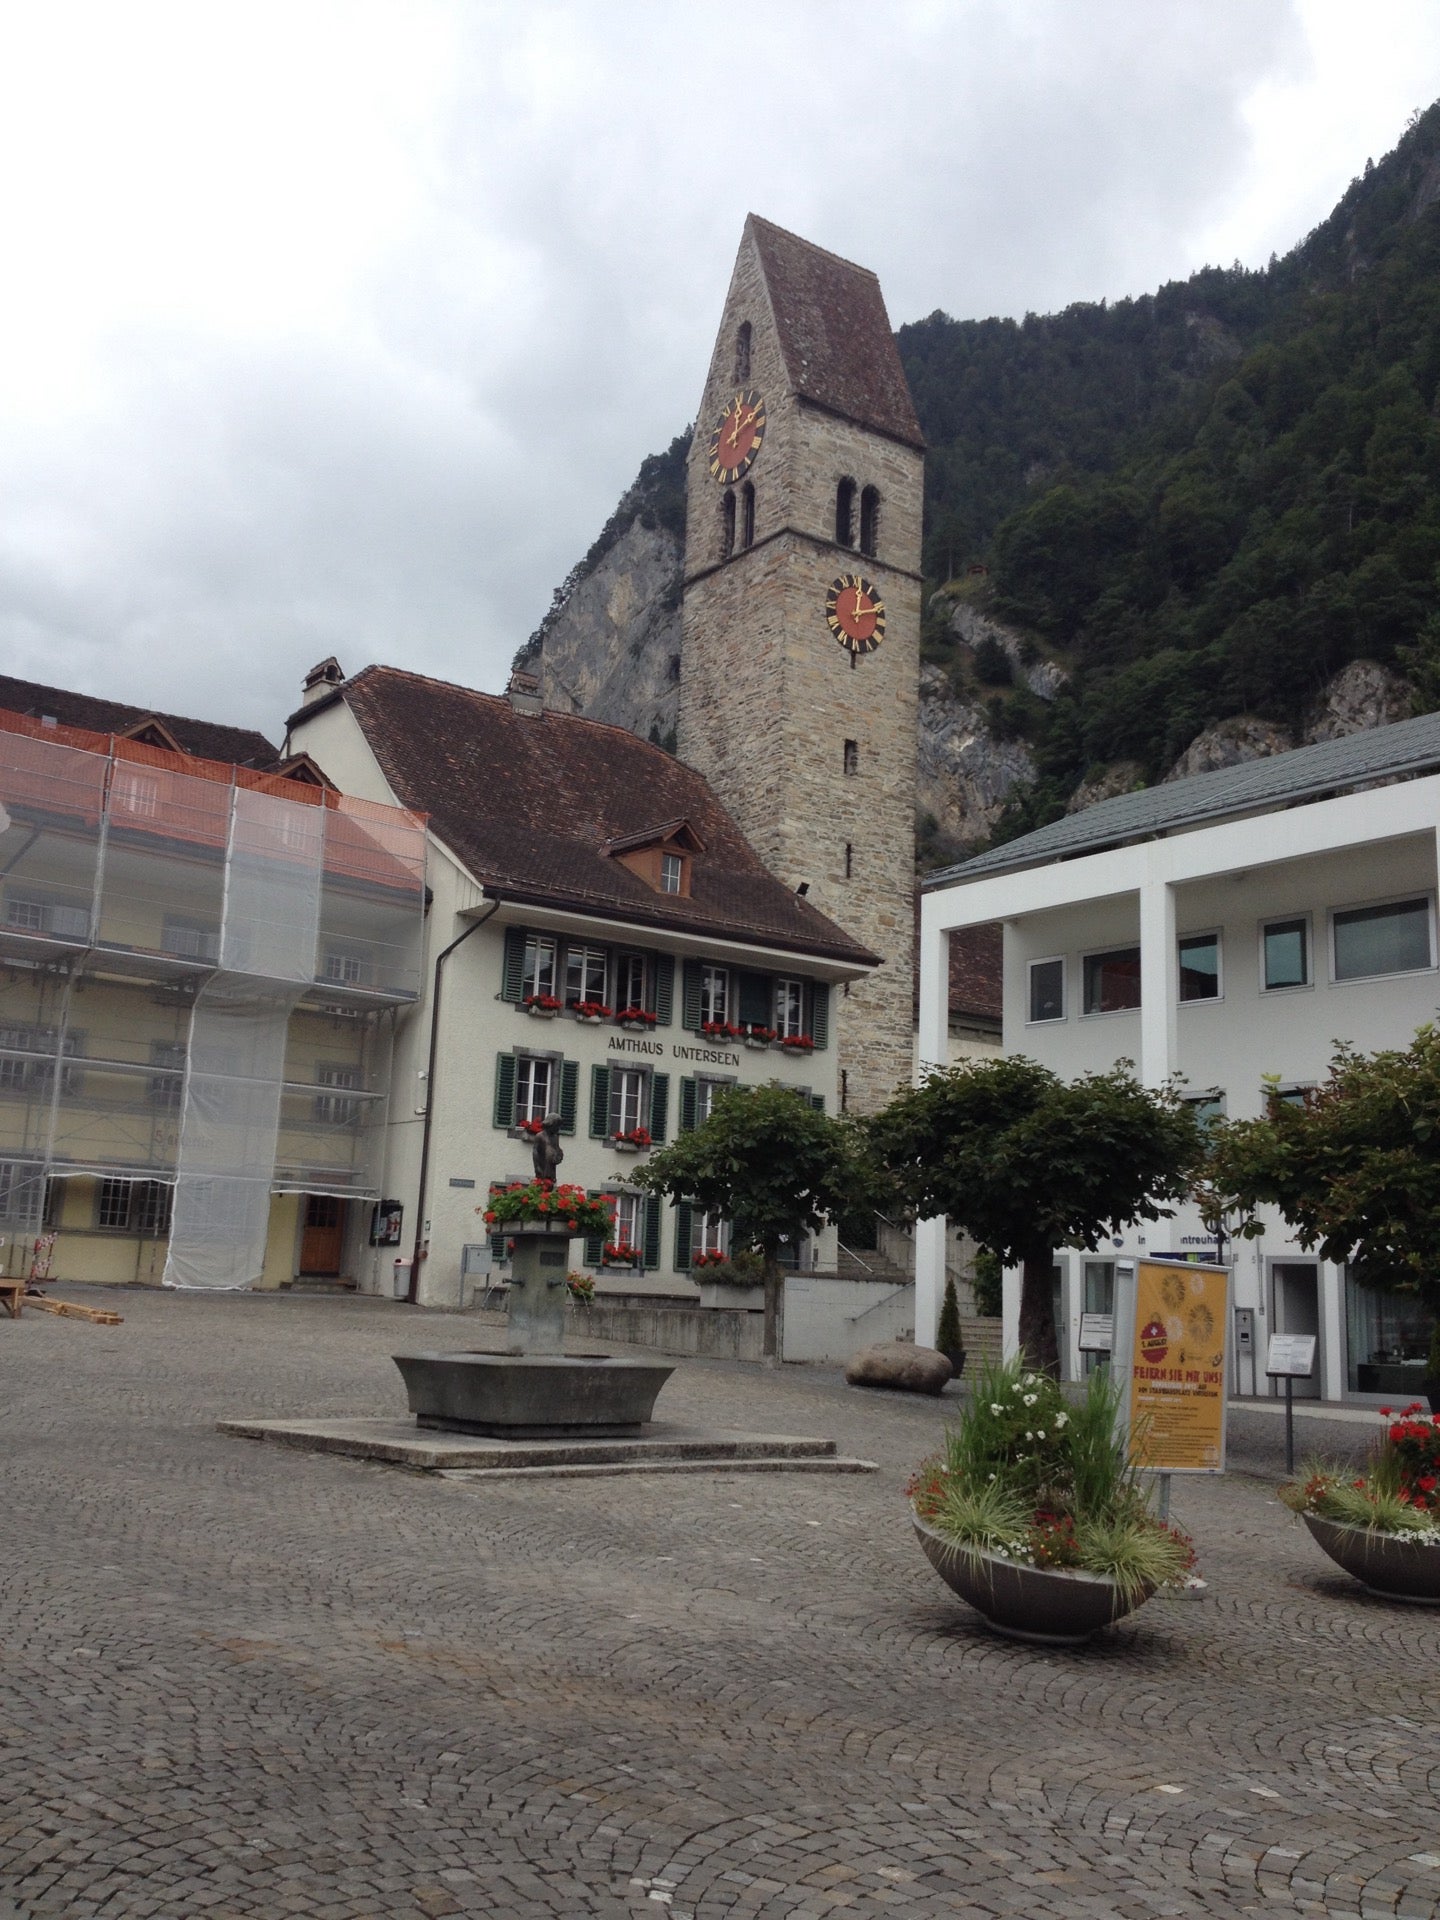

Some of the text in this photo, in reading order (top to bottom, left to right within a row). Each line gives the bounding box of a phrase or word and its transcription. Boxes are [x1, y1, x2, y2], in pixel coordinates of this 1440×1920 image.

[608, 1036, 740, 1067] AMTHAUS UNTERSEEN
[1134, 1366, 1166, 1380] FEIERN
[1169, 1369, 1183, 1382] SIE
[1186, 1370, 1200, 1382] MIT
[1203, 1371, 1223, 1386] UNS!
